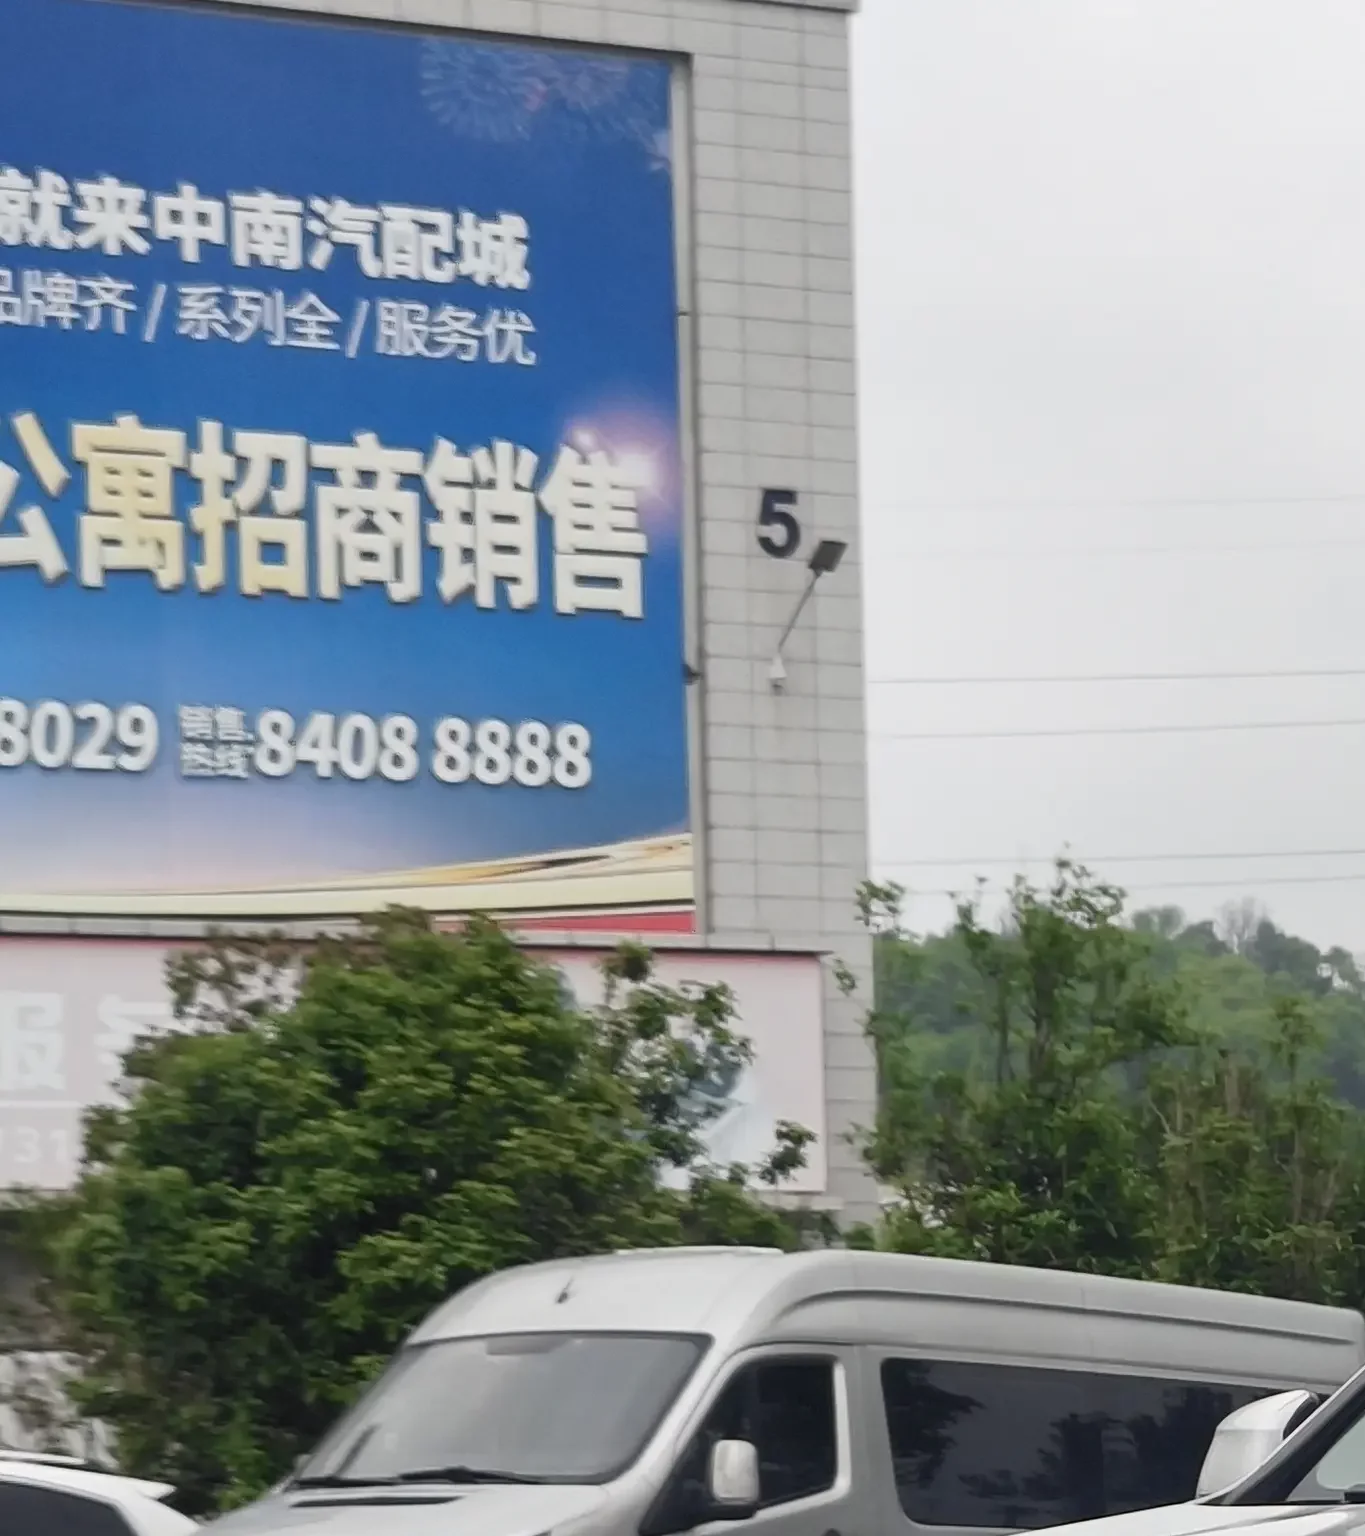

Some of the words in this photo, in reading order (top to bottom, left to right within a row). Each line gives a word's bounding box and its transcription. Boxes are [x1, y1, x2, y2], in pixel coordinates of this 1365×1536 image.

[0, 166, 531, 290] 就来中南汽配城
[0, 413, 648, 620] 公寓招商销售
[756, 488, 802, 558] 5
[0, 698, 160, 773] 8029
[254, 708, 419, 782] 8408
[431, 716, 592, 790] 8888
